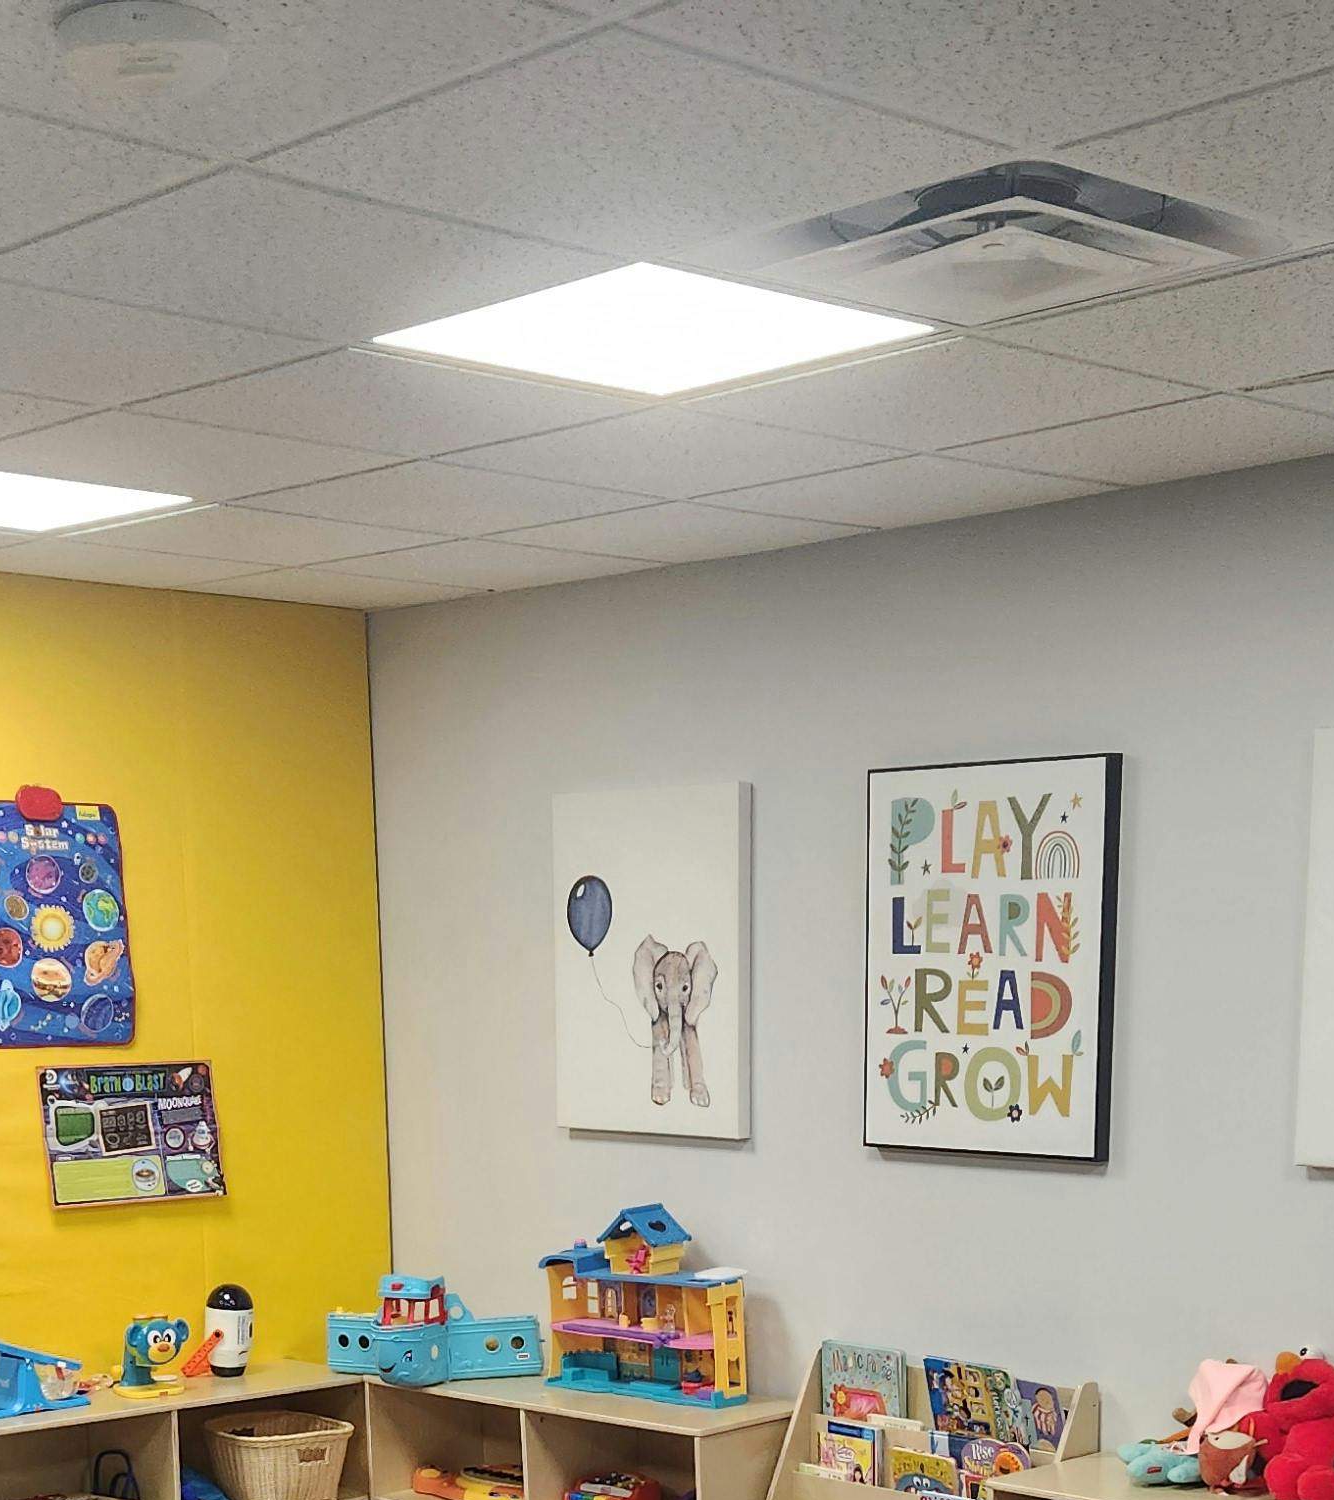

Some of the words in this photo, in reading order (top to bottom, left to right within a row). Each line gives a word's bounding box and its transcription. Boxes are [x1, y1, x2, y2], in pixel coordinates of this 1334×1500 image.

[20, 837, 69, 855] System
[24, 823, 60, 838] Solar
[890, 793, 1052, 885] PLAY
[892, 889, 1073, 963] LEARN
[914, 968, 1073, 1040] READ
[887, 1039, 1075, 1122] GROW
[971, 1440, 995, 1461] Rise
